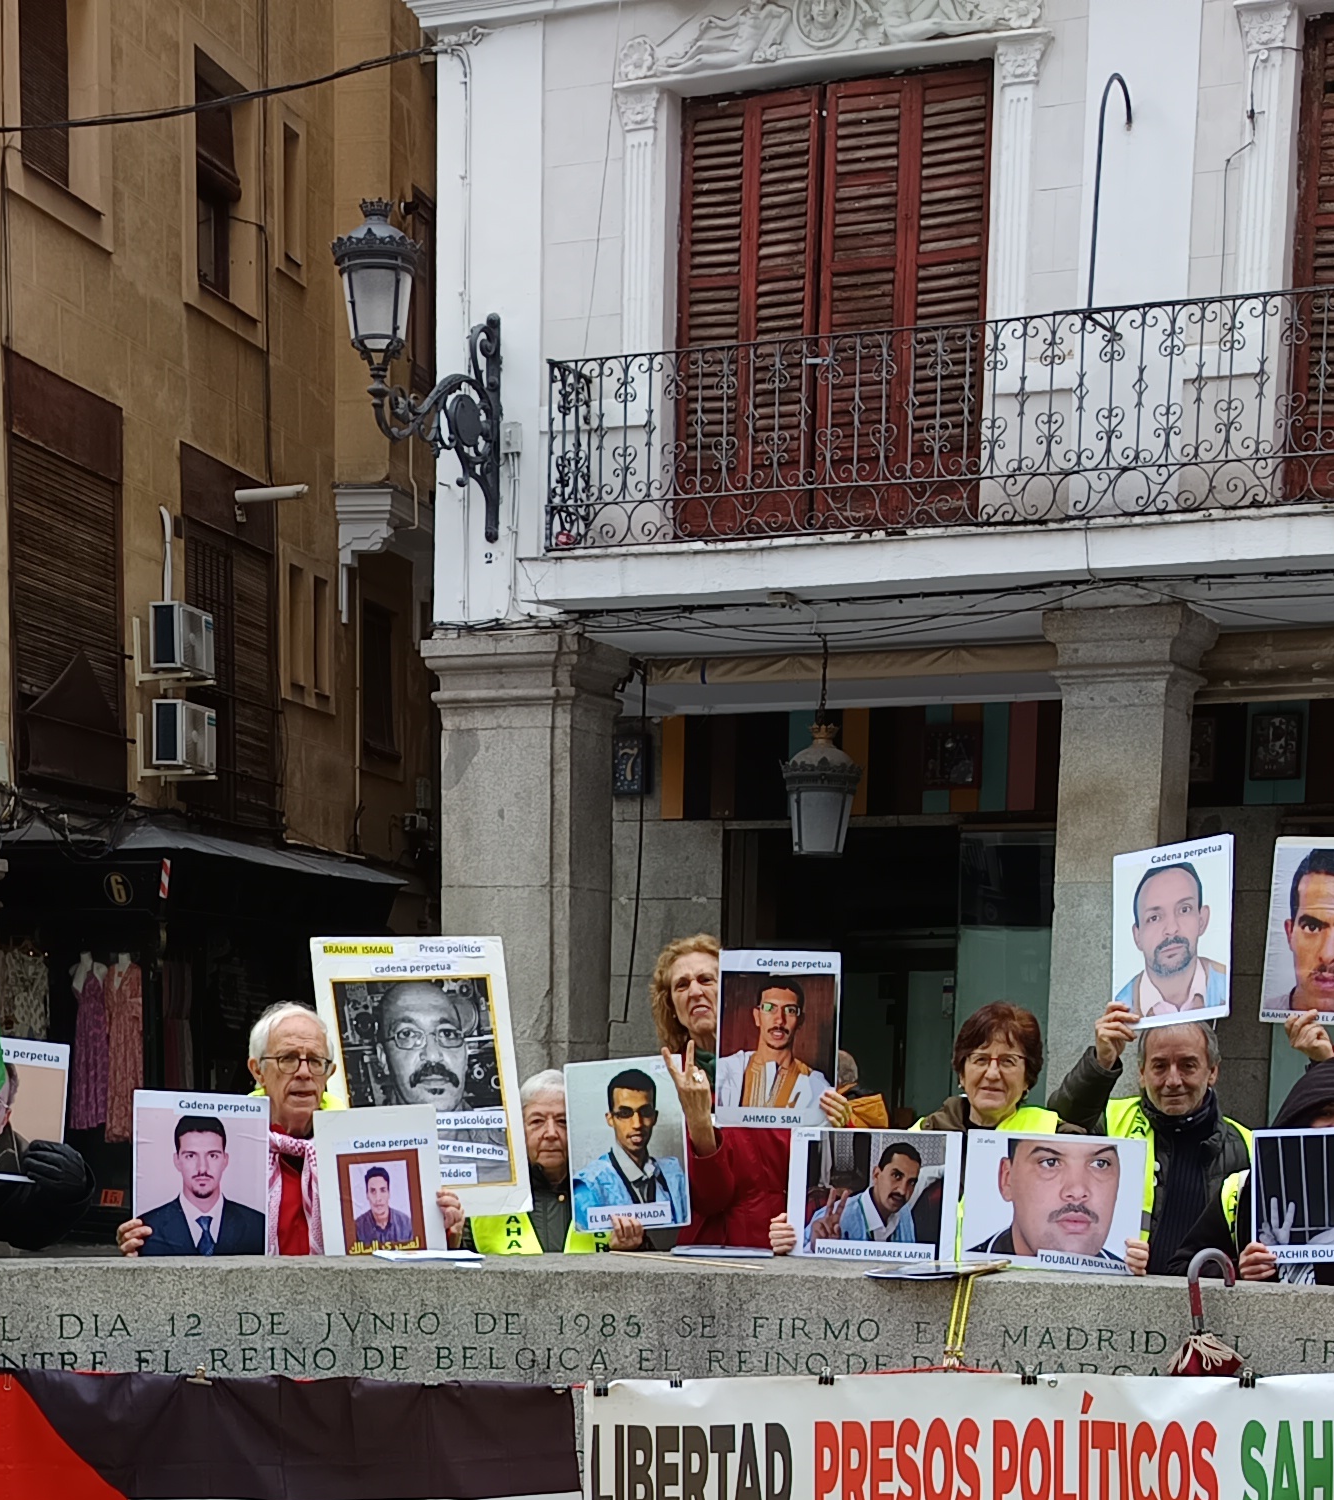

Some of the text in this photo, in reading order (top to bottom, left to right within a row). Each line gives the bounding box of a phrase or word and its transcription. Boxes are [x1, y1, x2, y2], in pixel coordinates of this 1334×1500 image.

[619, 748, 638, 780] 7
[1151, 844, 1221, 864] Cadena perpetua
[110, 875, 126, 902] 6
[322, 944, 394, 955] BRAHIM ISMAILI
[418, 942, 481, 955] Preso político
[374, 961, 452, 974] cadena perpetua
[756, 957, 832, 970] Cadena perpetua
[13, 1051, 59, 1063] perpetua
[178, 1100, 261, 1114] Cadena perpetua
[453, 1115, 504, 1127] psicológico
[742, 1114, 802, 1124] AHMED SBAI
[353, 1140, 387, 1150] Cadena
[388, 1136, 429, 1148] perpetua
[452, 1143, 465, 1153] en
[465, 1144, 475, 1154] el
[476, 1145, 504, 1157] pecho
[589, 1215, 599, 1223] EL
[634, 1209, 666, 1220] KHADA
[816, 1246, 932, 1259] MOHAMED EMBAREK LAFKIR
[1039, 1253, 1126, 1271] TOUBALI ABDELLAH
[59, 1314, 132, 1339] DIA
[168, 1314, 202, 1337] 12
[237, 1312, 290, 1335] DE
[474, 1312, 521, 1335] DE
[558, 1314, 641, 1338] 1985
[676, 1316, 716, 1338] SE
[752, 1318, 880, 1342] FIRMO
[1001, 1326, 1167, 1354] MADRID
[137, 1347, 829, 1374] EL REINO DE EL REINO
